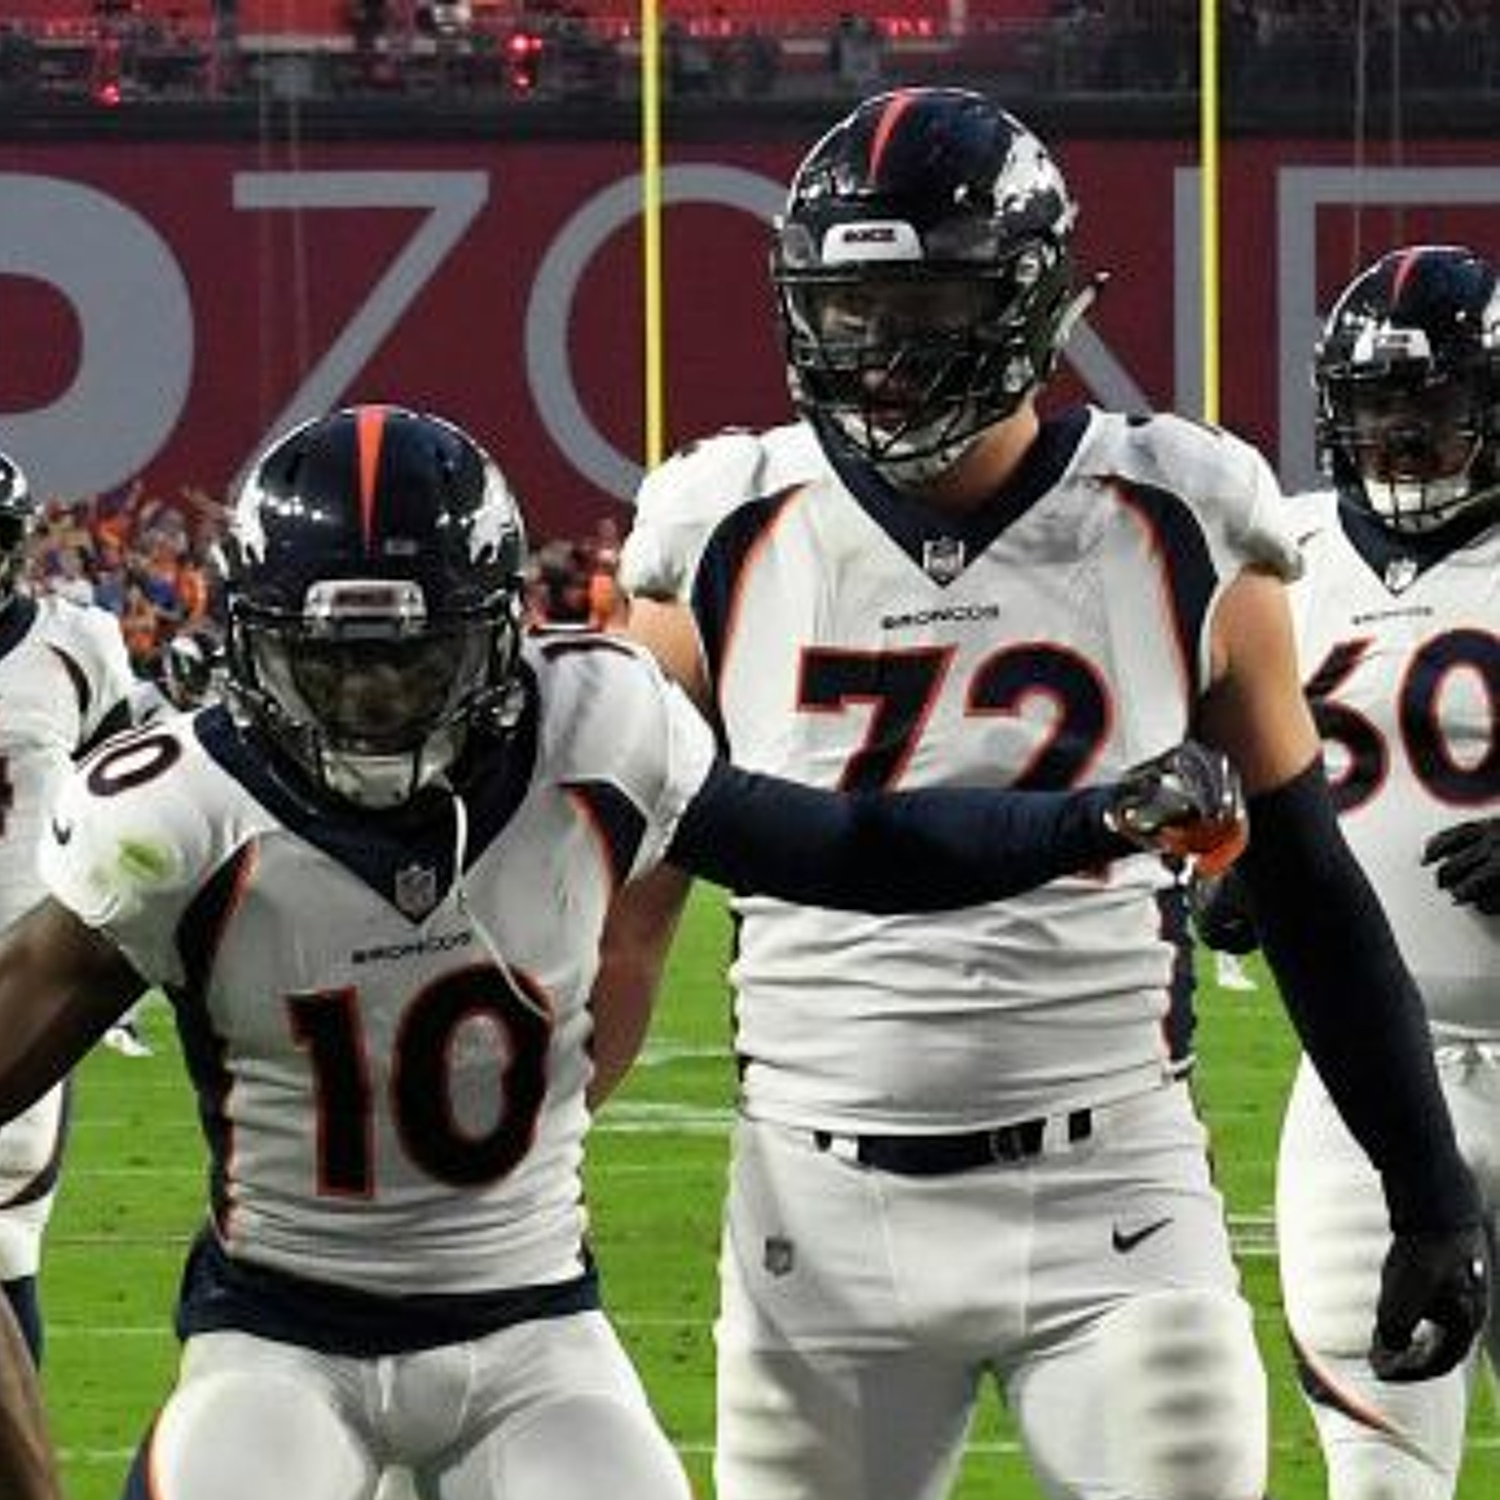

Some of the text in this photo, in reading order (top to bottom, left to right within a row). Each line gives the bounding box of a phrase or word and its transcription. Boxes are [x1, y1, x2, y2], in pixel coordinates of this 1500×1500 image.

[793, 640, 1116, 886] 72
[1303, 628, 1500, 815] 60
[284, 962, 554, 1199] 10
